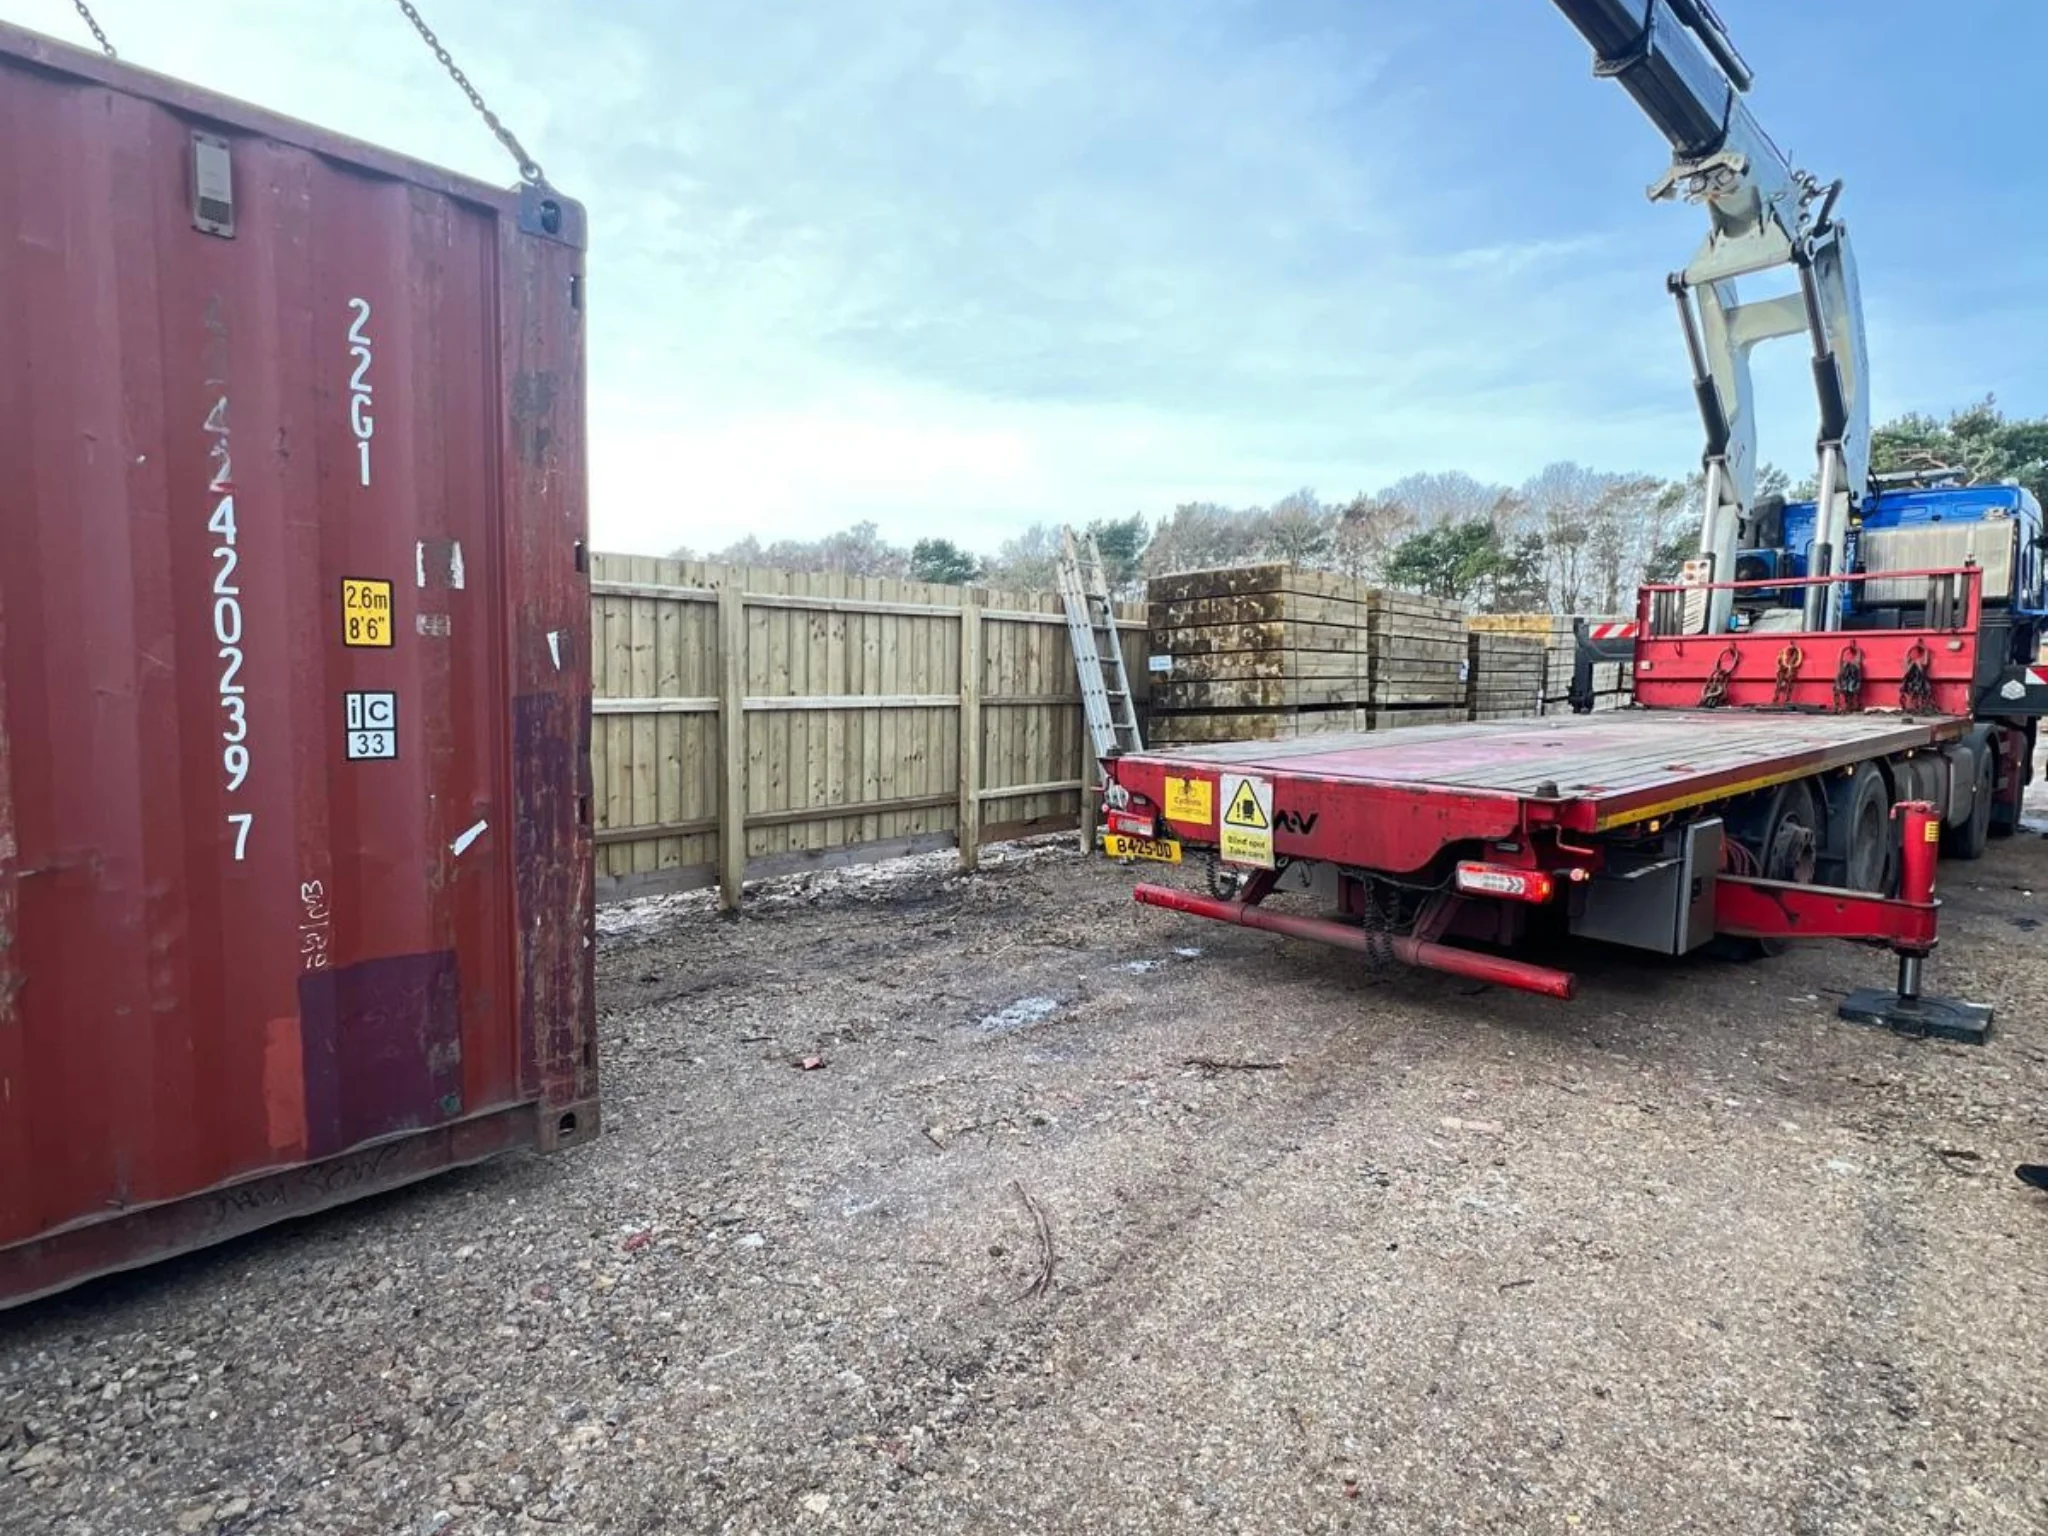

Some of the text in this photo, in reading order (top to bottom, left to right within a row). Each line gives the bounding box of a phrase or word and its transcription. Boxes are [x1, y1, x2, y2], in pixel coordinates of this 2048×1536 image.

[348, 298, 373, 486] 22G1
[346, 585, 388, 610] 2.6m
[356, 733, 385, 755] 33
